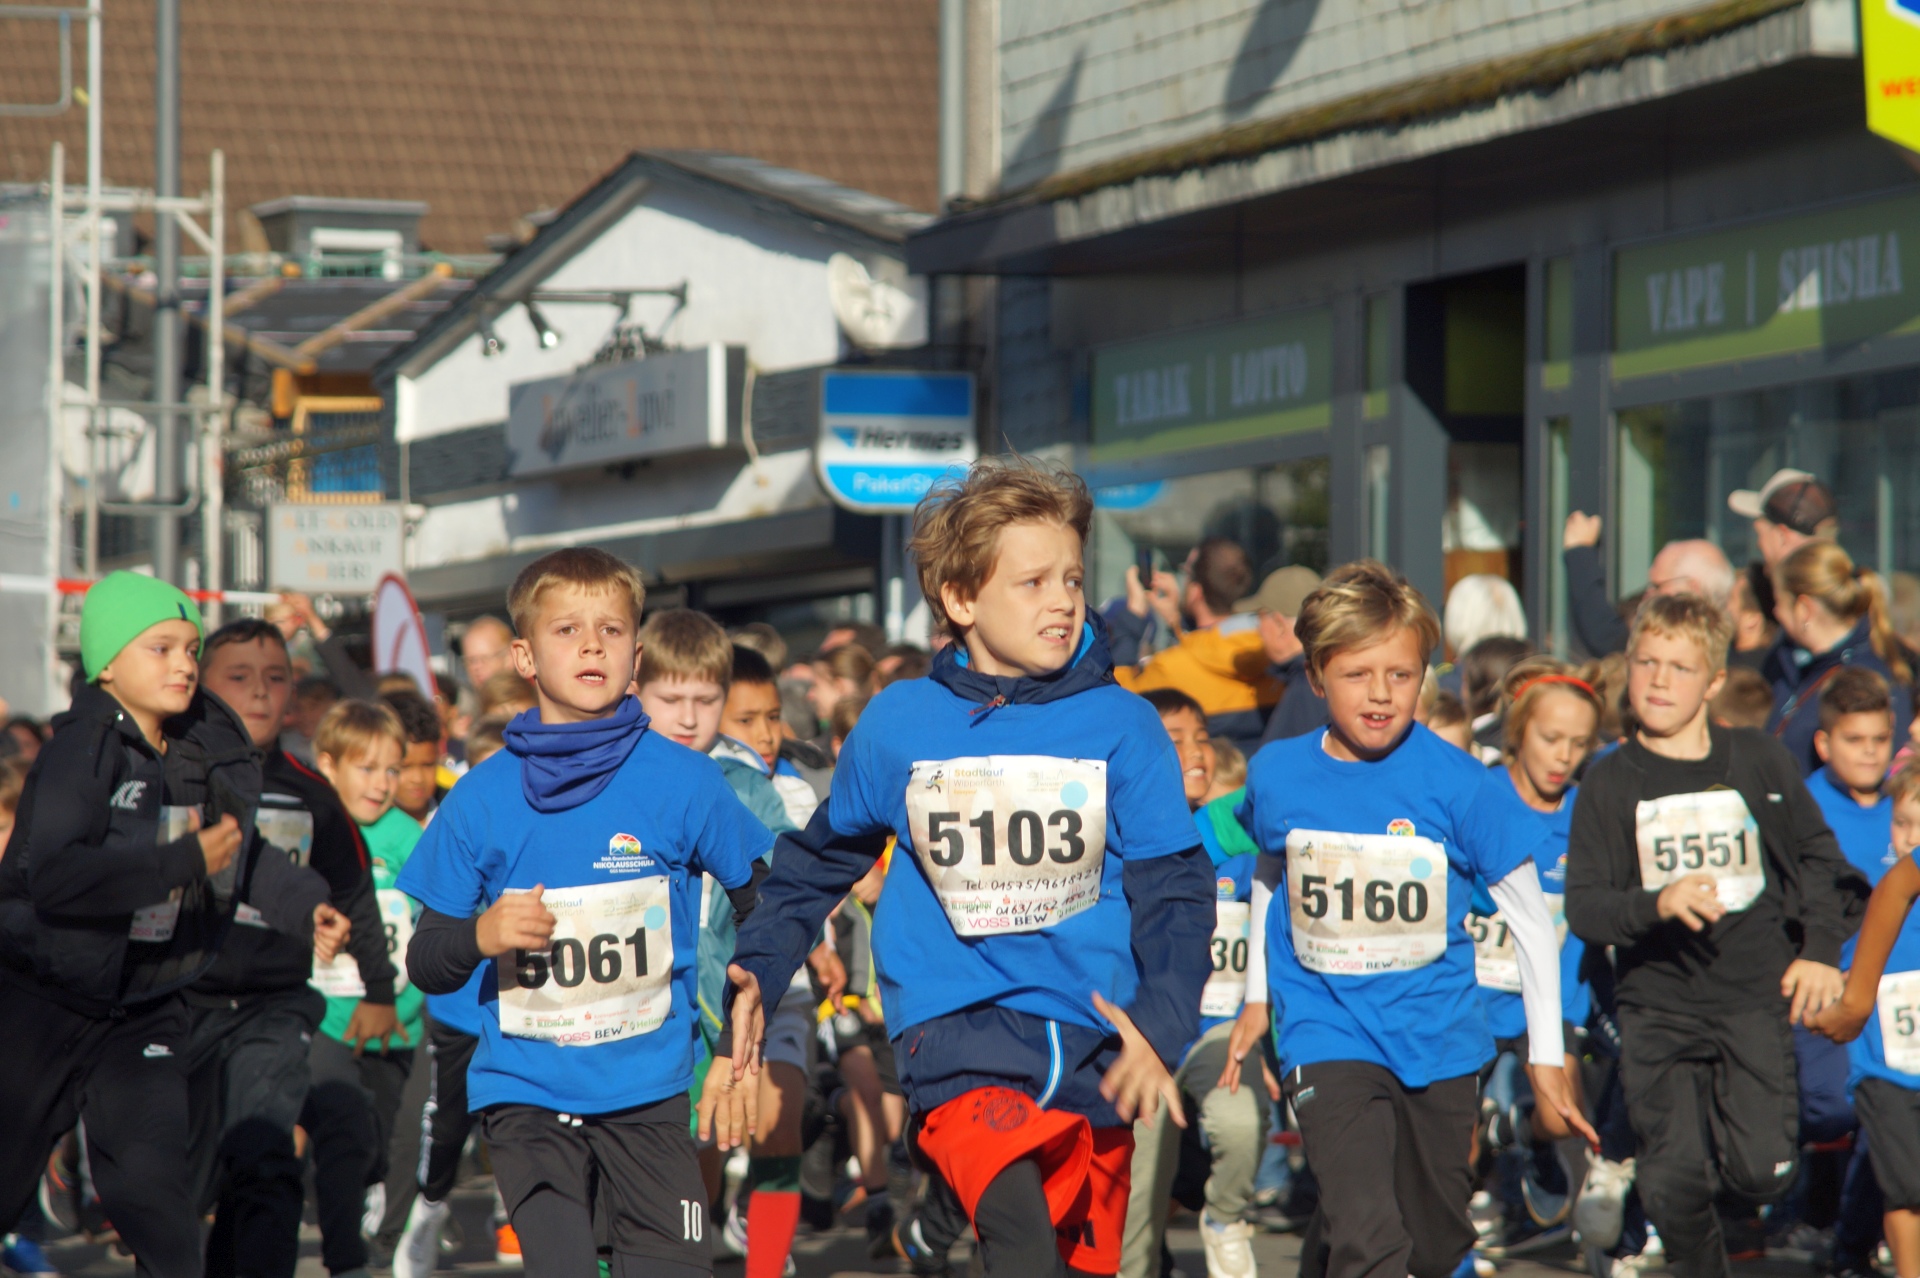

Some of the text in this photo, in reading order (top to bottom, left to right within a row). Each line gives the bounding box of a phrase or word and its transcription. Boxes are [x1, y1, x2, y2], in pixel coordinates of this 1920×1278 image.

[1879, 78, 1920, 98] WE
[1648, 231, 1904, 334] VAPE SHISHA
[1231, 342, 1307, 406] LOTTO
[862, 427, 964, 450] Hermes
[954, 768, 1004, 777] Stadtlauf
[954, 779, 1004, 788] Wipperfürth
[928, 809, 1086, 867] 5103
[1653, 830, 1748, 871] 5551
[593, 860, 655, 869] NIKOLAUSSCHULE
[545, 898, 583, 909] adtlauf
[1301, 874, 1428, 923] 5160
[968, 917, 1010, 929] VOSS
[1014, 913, 1047, 926] BEW
[515, 926, 648, 989] 5061
[1366, 961, 1393, 969] BEW
[553, 1032, 590, 1042] VOSS
[595, 1026, 622, 1039] BEW
[636, 1017, 663, 1029] Helios
[681, 1199, 702, 1242] 10
